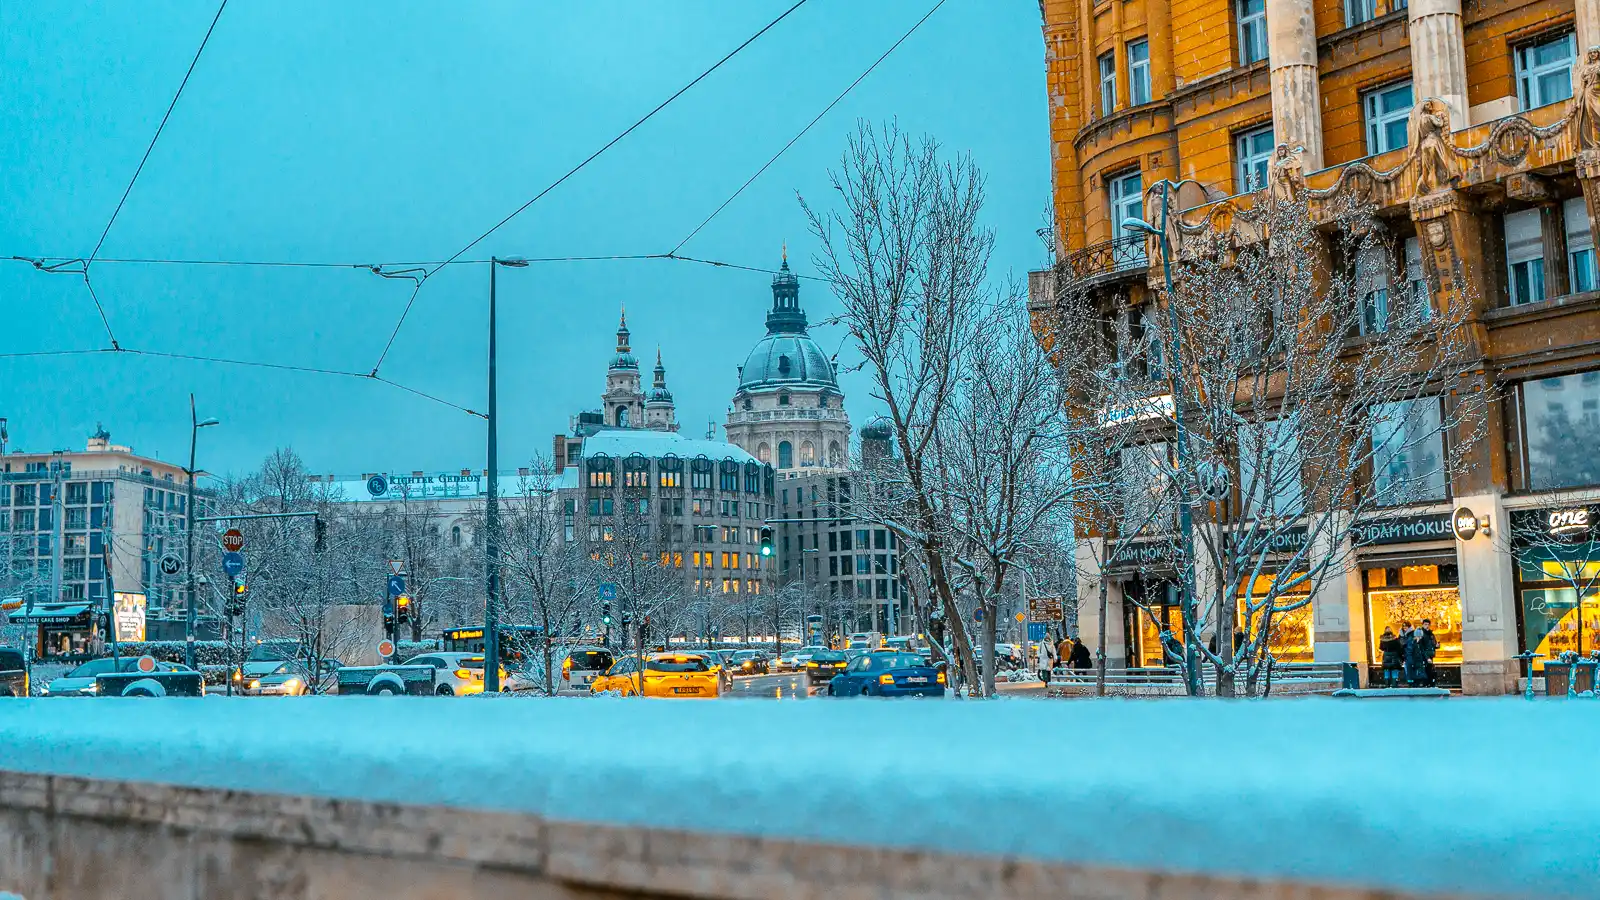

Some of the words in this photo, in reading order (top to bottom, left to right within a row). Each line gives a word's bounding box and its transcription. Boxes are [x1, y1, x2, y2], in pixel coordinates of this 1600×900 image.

[1549, 511, 1588, 527] one
[1403, 519, 1453, 537] MÓKUS
[223, 535, 243, 546] STOP
